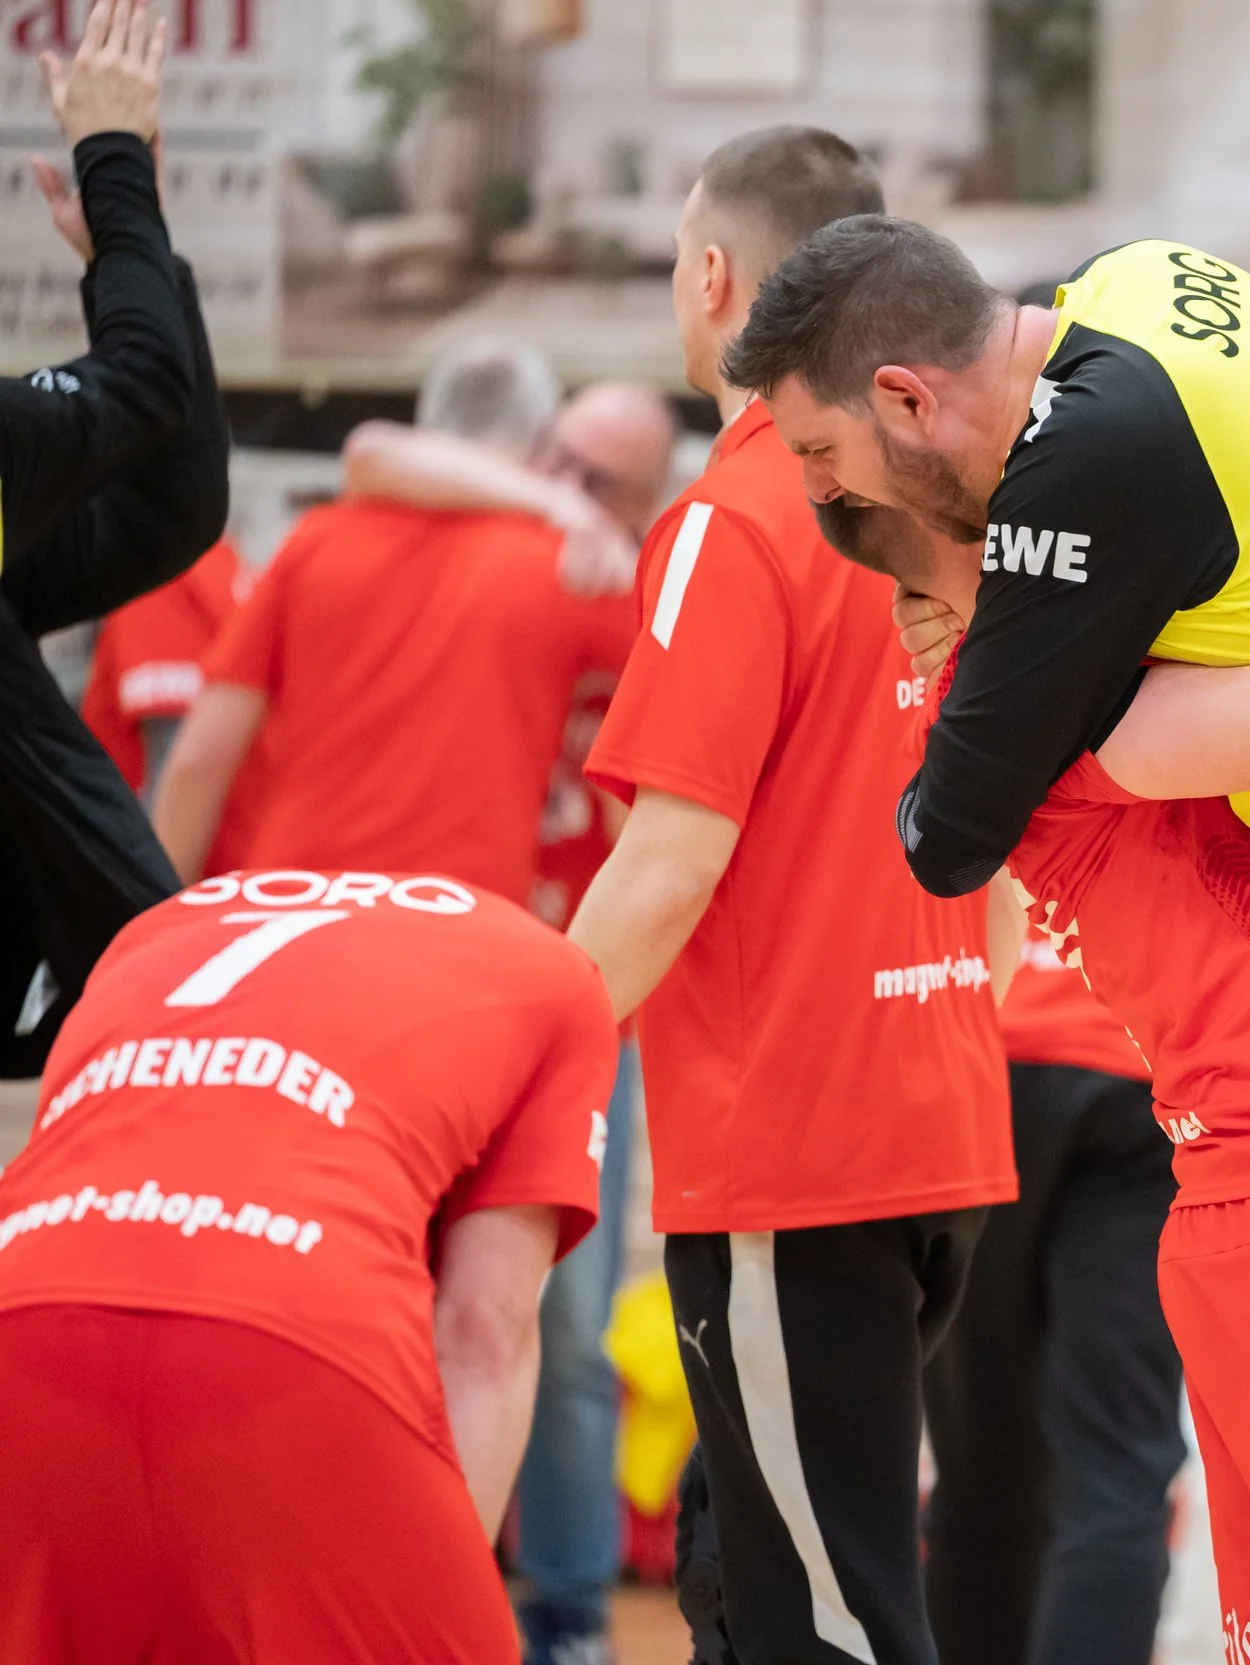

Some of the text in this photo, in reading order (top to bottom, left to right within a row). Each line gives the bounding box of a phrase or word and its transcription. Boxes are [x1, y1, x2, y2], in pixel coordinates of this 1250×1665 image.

[1168, 252, 1241, 358] SORG
[982, 523, 1091, 583] EWE
[179, 870, 477, 914] SORG
[165, 910, 351, 1007] 7
